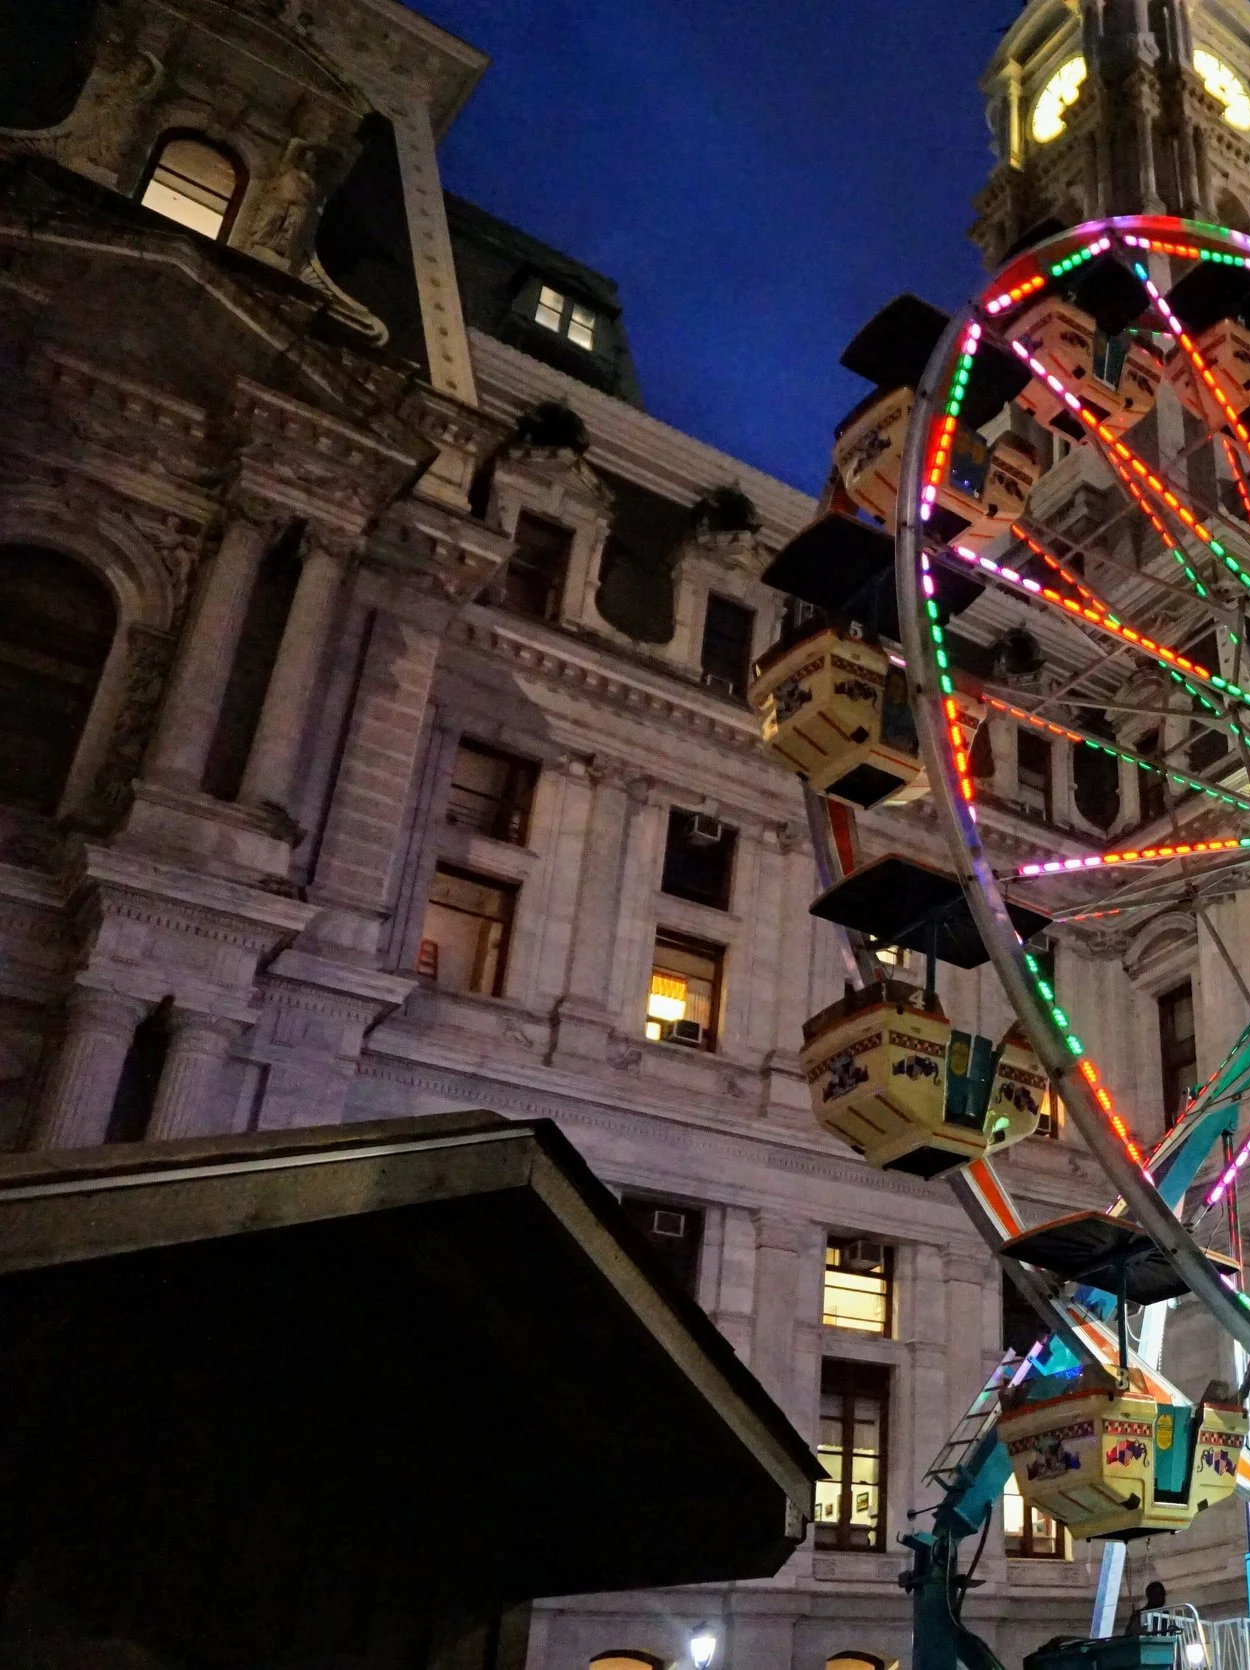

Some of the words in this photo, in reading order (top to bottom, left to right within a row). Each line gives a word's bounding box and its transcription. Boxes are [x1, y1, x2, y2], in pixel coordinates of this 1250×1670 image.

[849, 620, 864, 639] 5
[909, 989, 925, 1009] 4
[1115, 1368, 1129, 1390] 3
